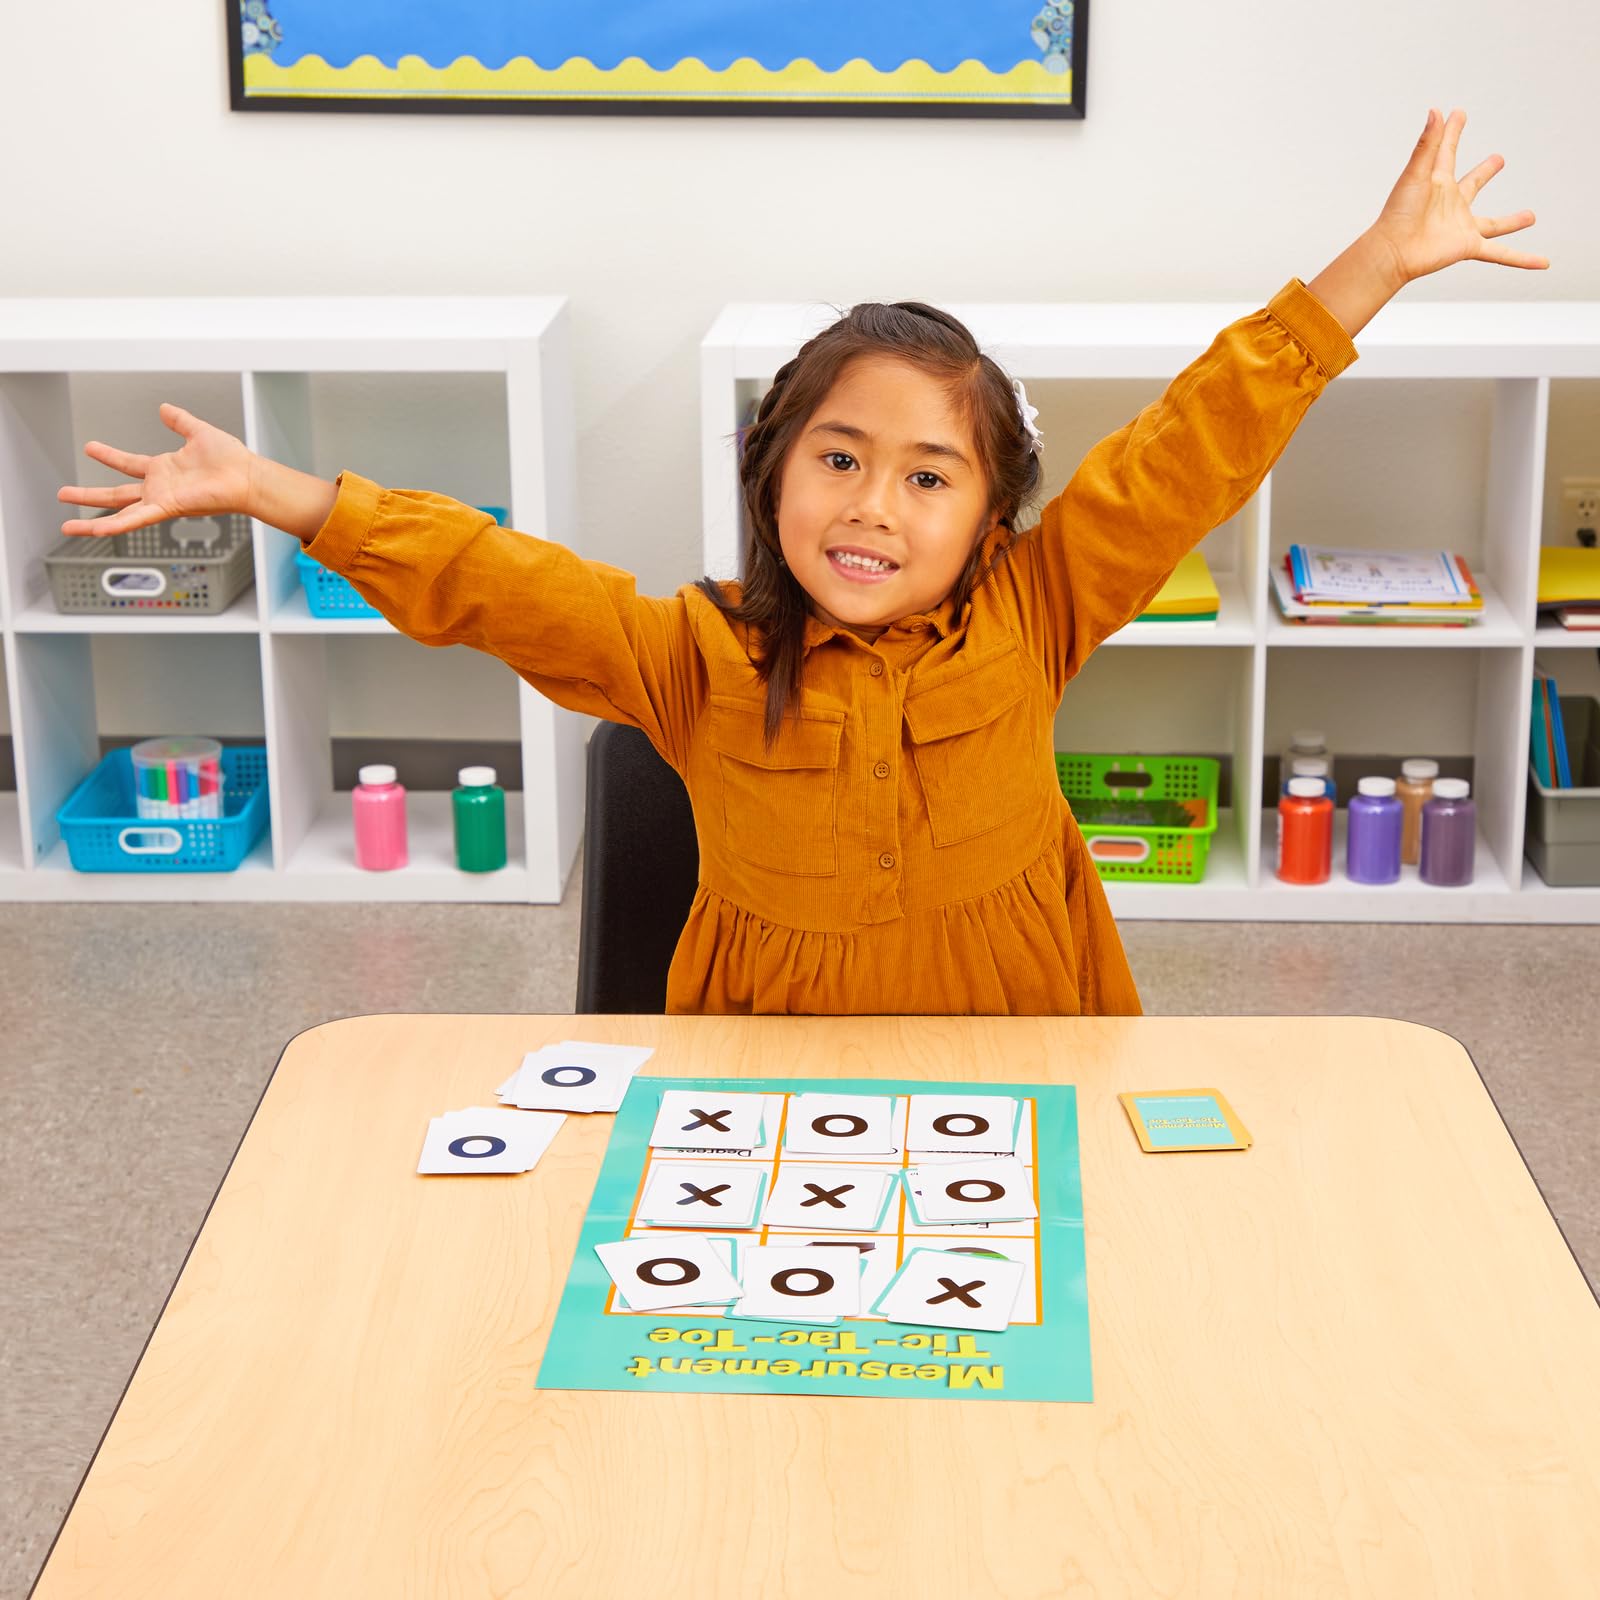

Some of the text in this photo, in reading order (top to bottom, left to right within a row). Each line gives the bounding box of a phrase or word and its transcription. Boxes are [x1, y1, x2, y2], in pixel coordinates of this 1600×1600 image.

[541, 1066, 597, 1088] O
[681, 1108, 733, 1132] X
[811, 1114, 869, 1138] O
[932, 1113, 990, 1137] O
[448, 1135, 507, 1159] O
[676, 1182, 732, 1207] X
[799, 1183, 855, 1209] X
[945, 1179, 1006, 1203] O
[636, 1257, 701, 1286] O
[770, 1267, 835, 1297] O
[925, 1277, 986, 1309] X
[628, 1355, 1006, 1390] Measurement
